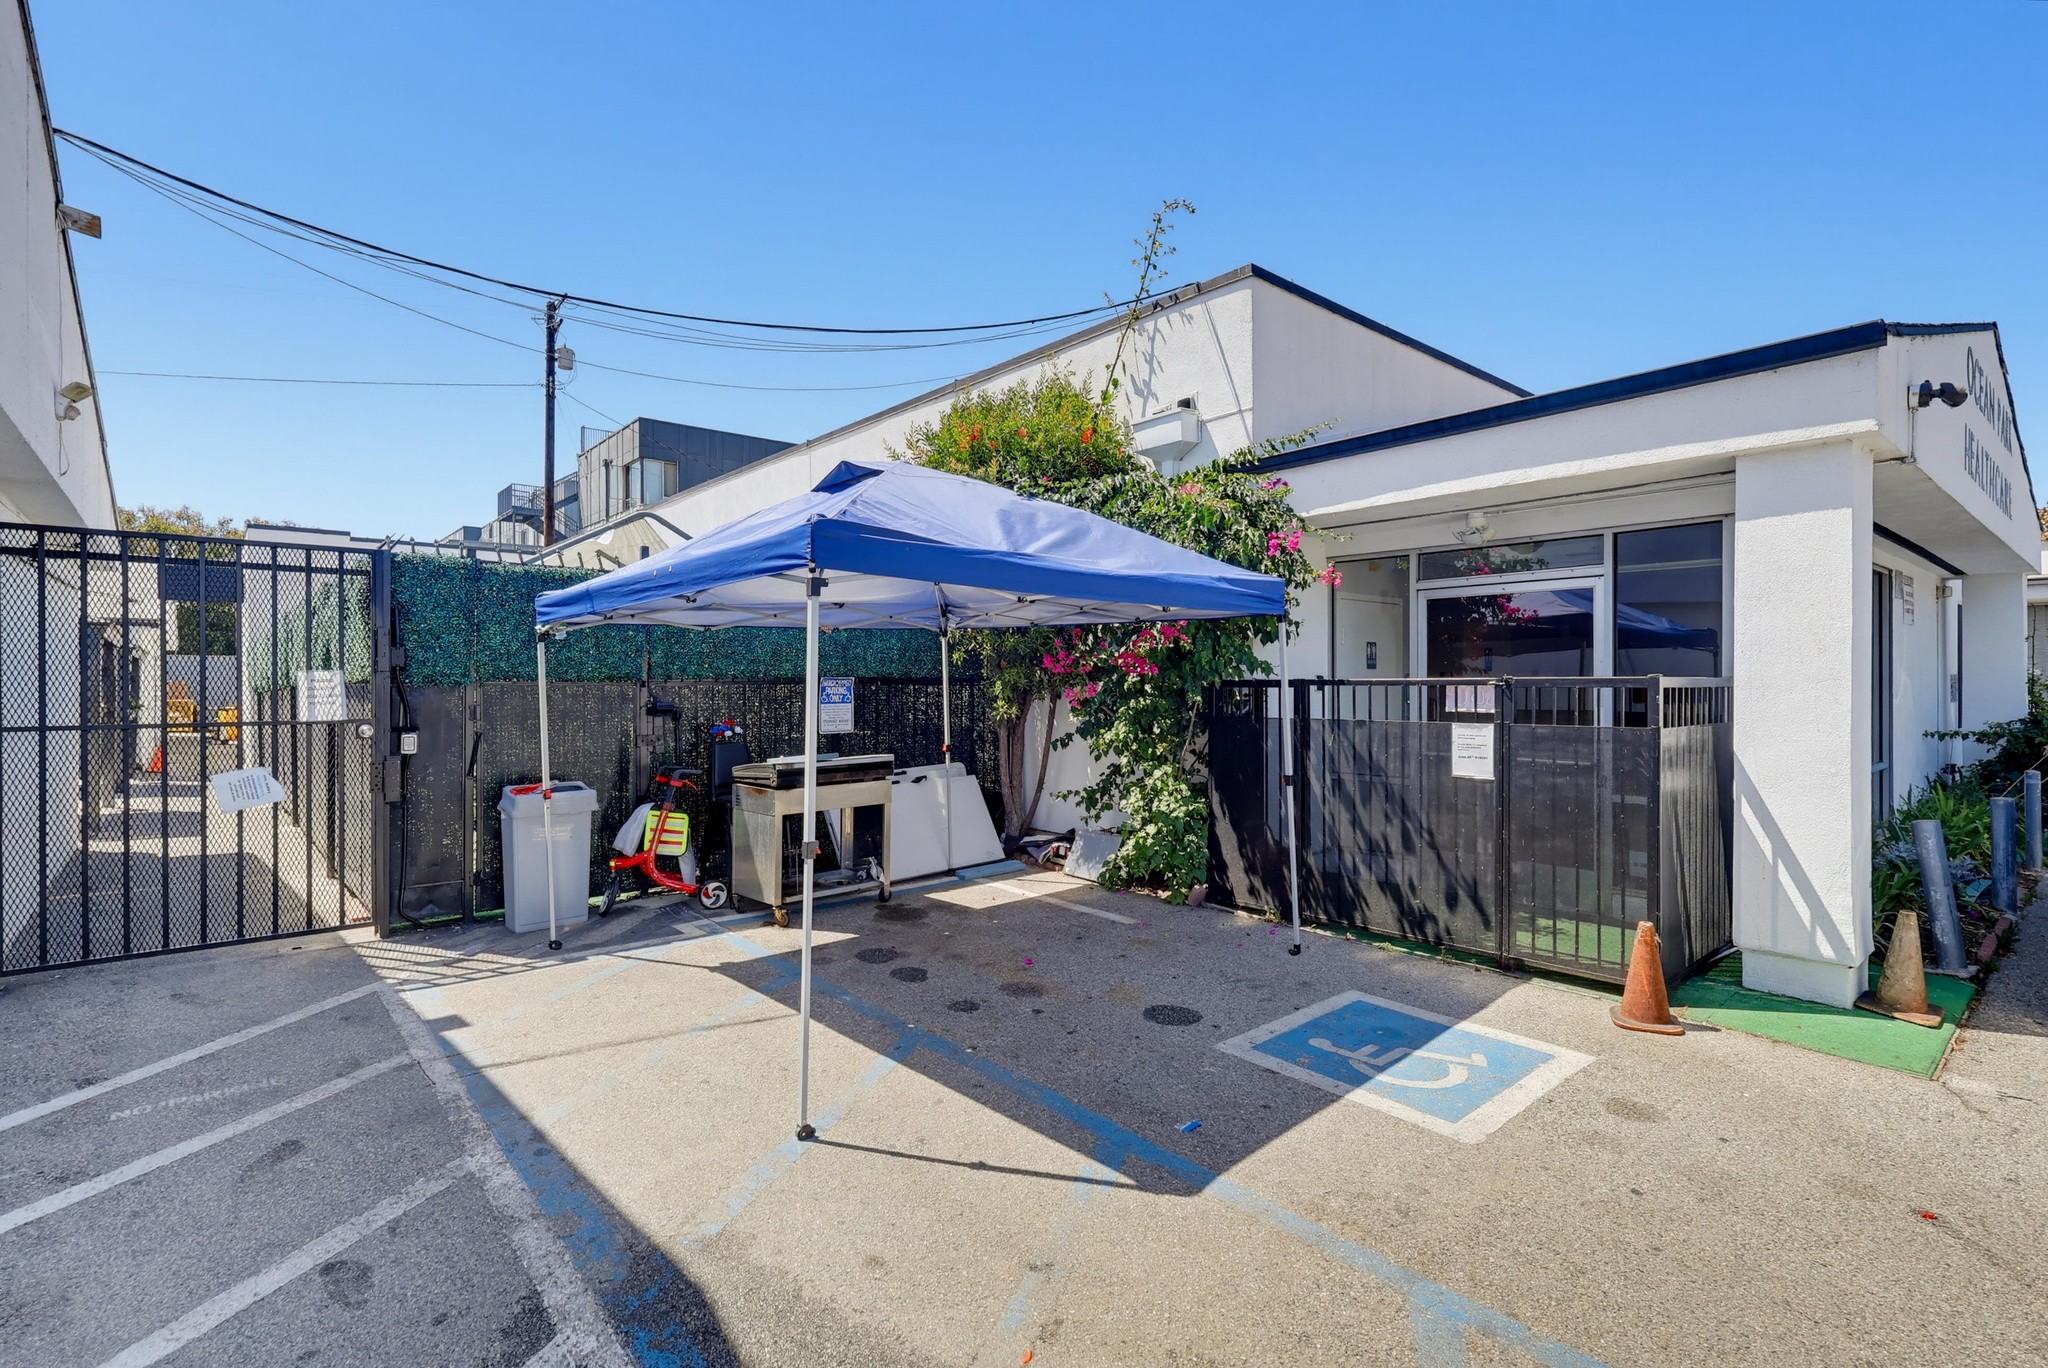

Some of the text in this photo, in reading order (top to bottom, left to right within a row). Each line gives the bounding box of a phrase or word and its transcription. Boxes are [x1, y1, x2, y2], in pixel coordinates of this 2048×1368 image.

[1967, 346, 2012, 456] OCEAN PARK
[1964, 423, 2012, 520] HEALTHCARE
